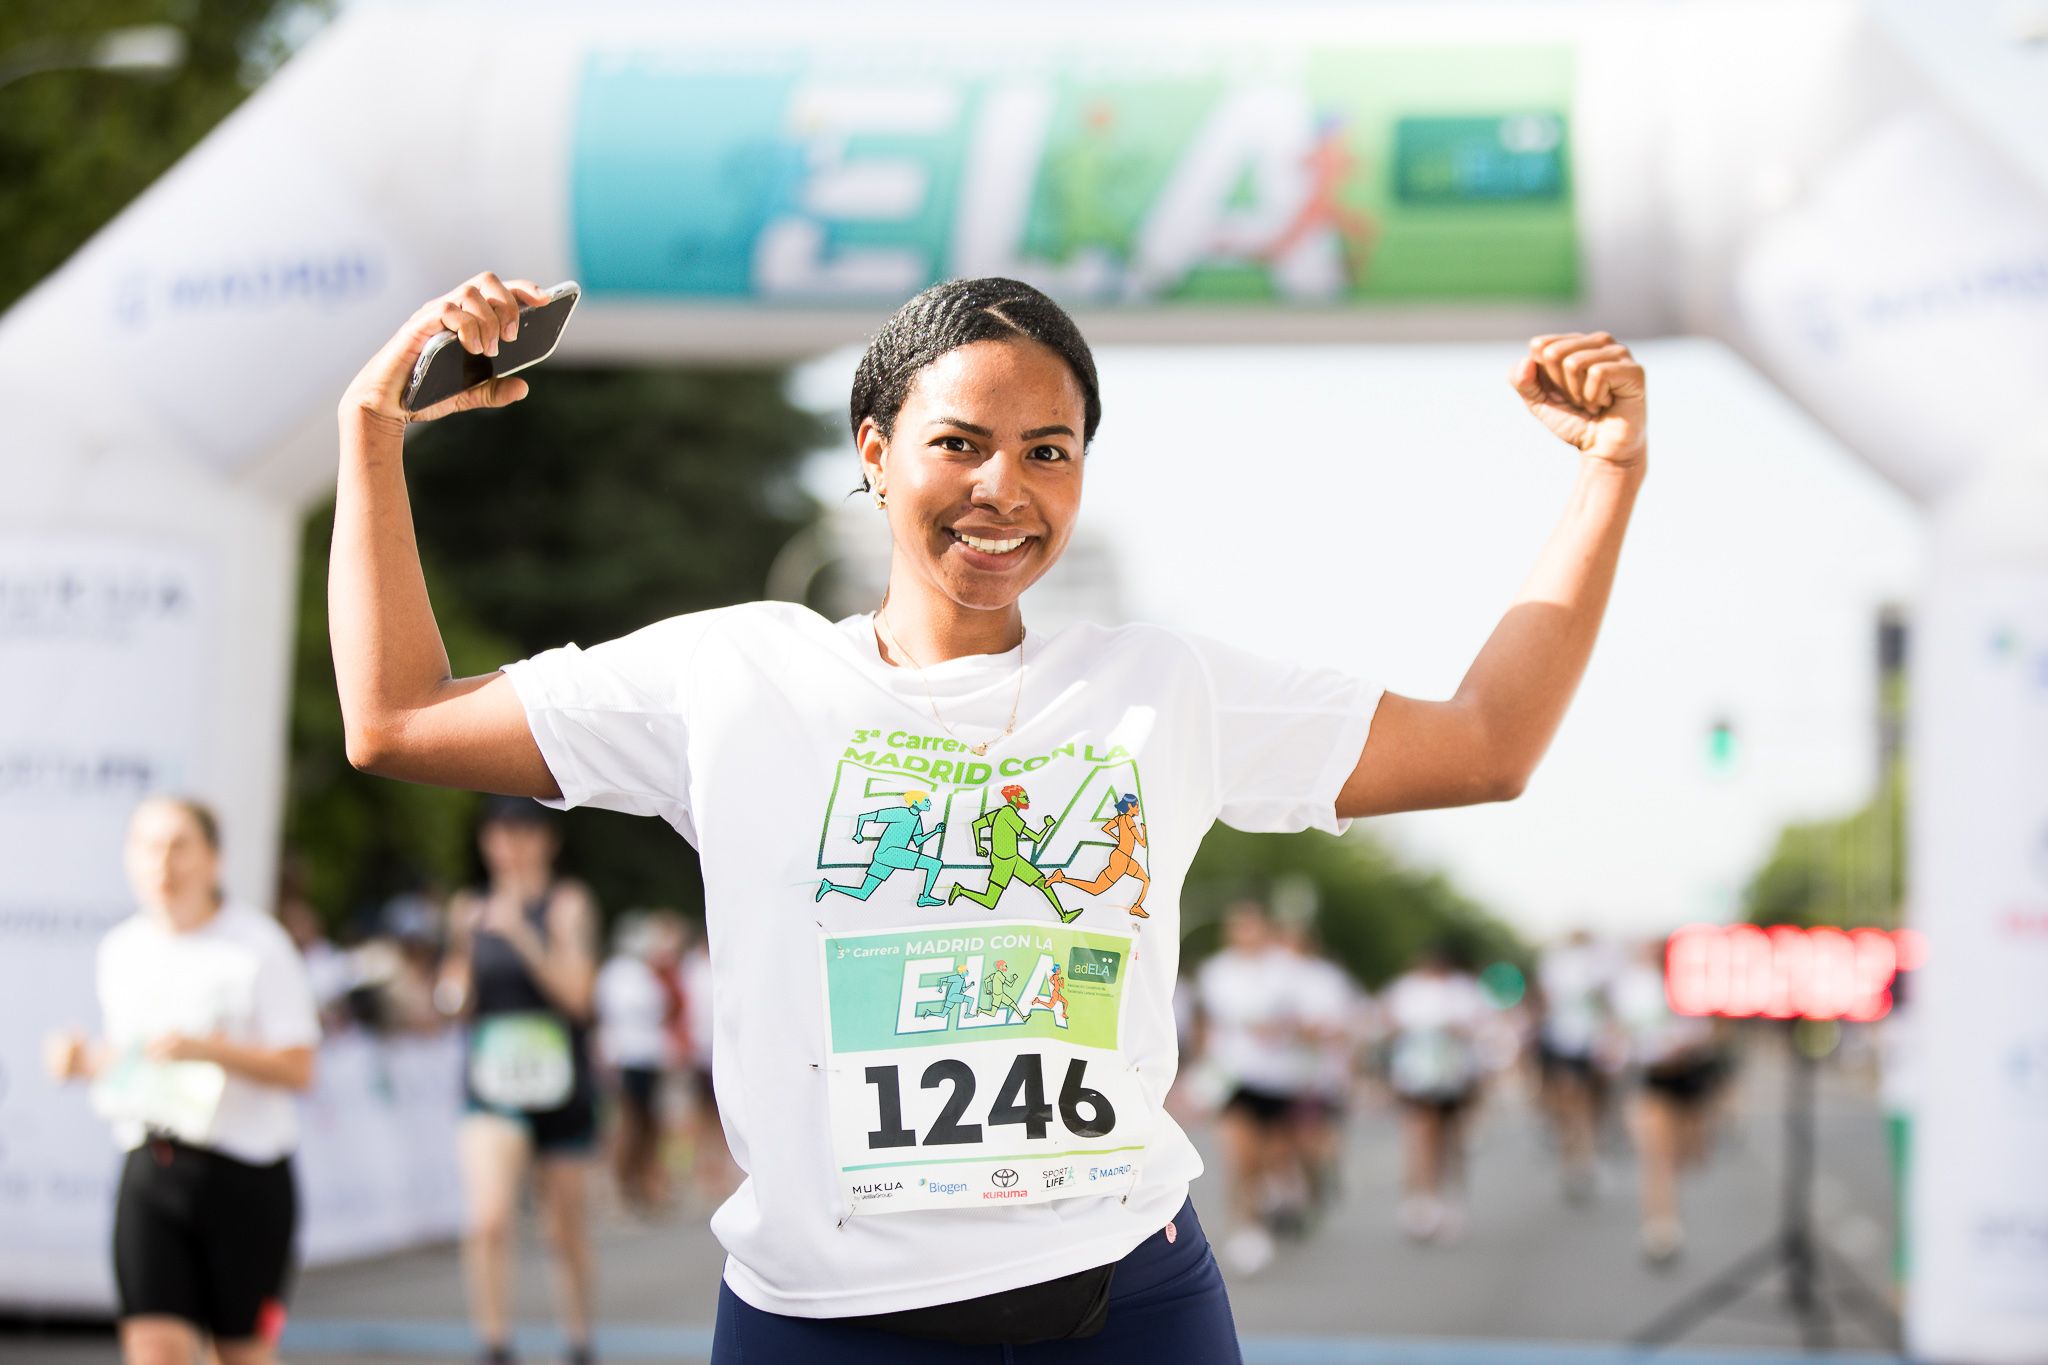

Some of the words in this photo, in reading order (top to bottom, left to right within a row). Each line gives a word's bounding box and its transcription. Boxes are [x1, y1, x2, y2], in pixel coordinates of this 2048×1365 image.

[752, 85, 1358, 304] ELA
[887, 730, 986, 757] Carrer
[843, 746, 993, 785] MADRID
[998, 742, 1075, 777] CON
[1083, 744, 1131, 762] LA
[816, 758, 1151, 882] ELA
[853, 944, 899, 958] Carrera
[905, 936, 984, 956] MADRID
[990, 934, 1031, 950] CON
[1036, 935, 1054, 951] LA
[1074, 962, 1110, 977] adELA
[894, 952, 1070, 1036] ELA
[864, 1053, 1116, 1149] 1246
[1042, 1166, 1068, 1179] SPORT
[1046, 1176, 1064, 1188] LIFE
[1099, 1164, 1131, 1178] MADRID
[852, 1181, 904, 1195] MUKUA
[929, 1182, 968, 1195] Biogen
